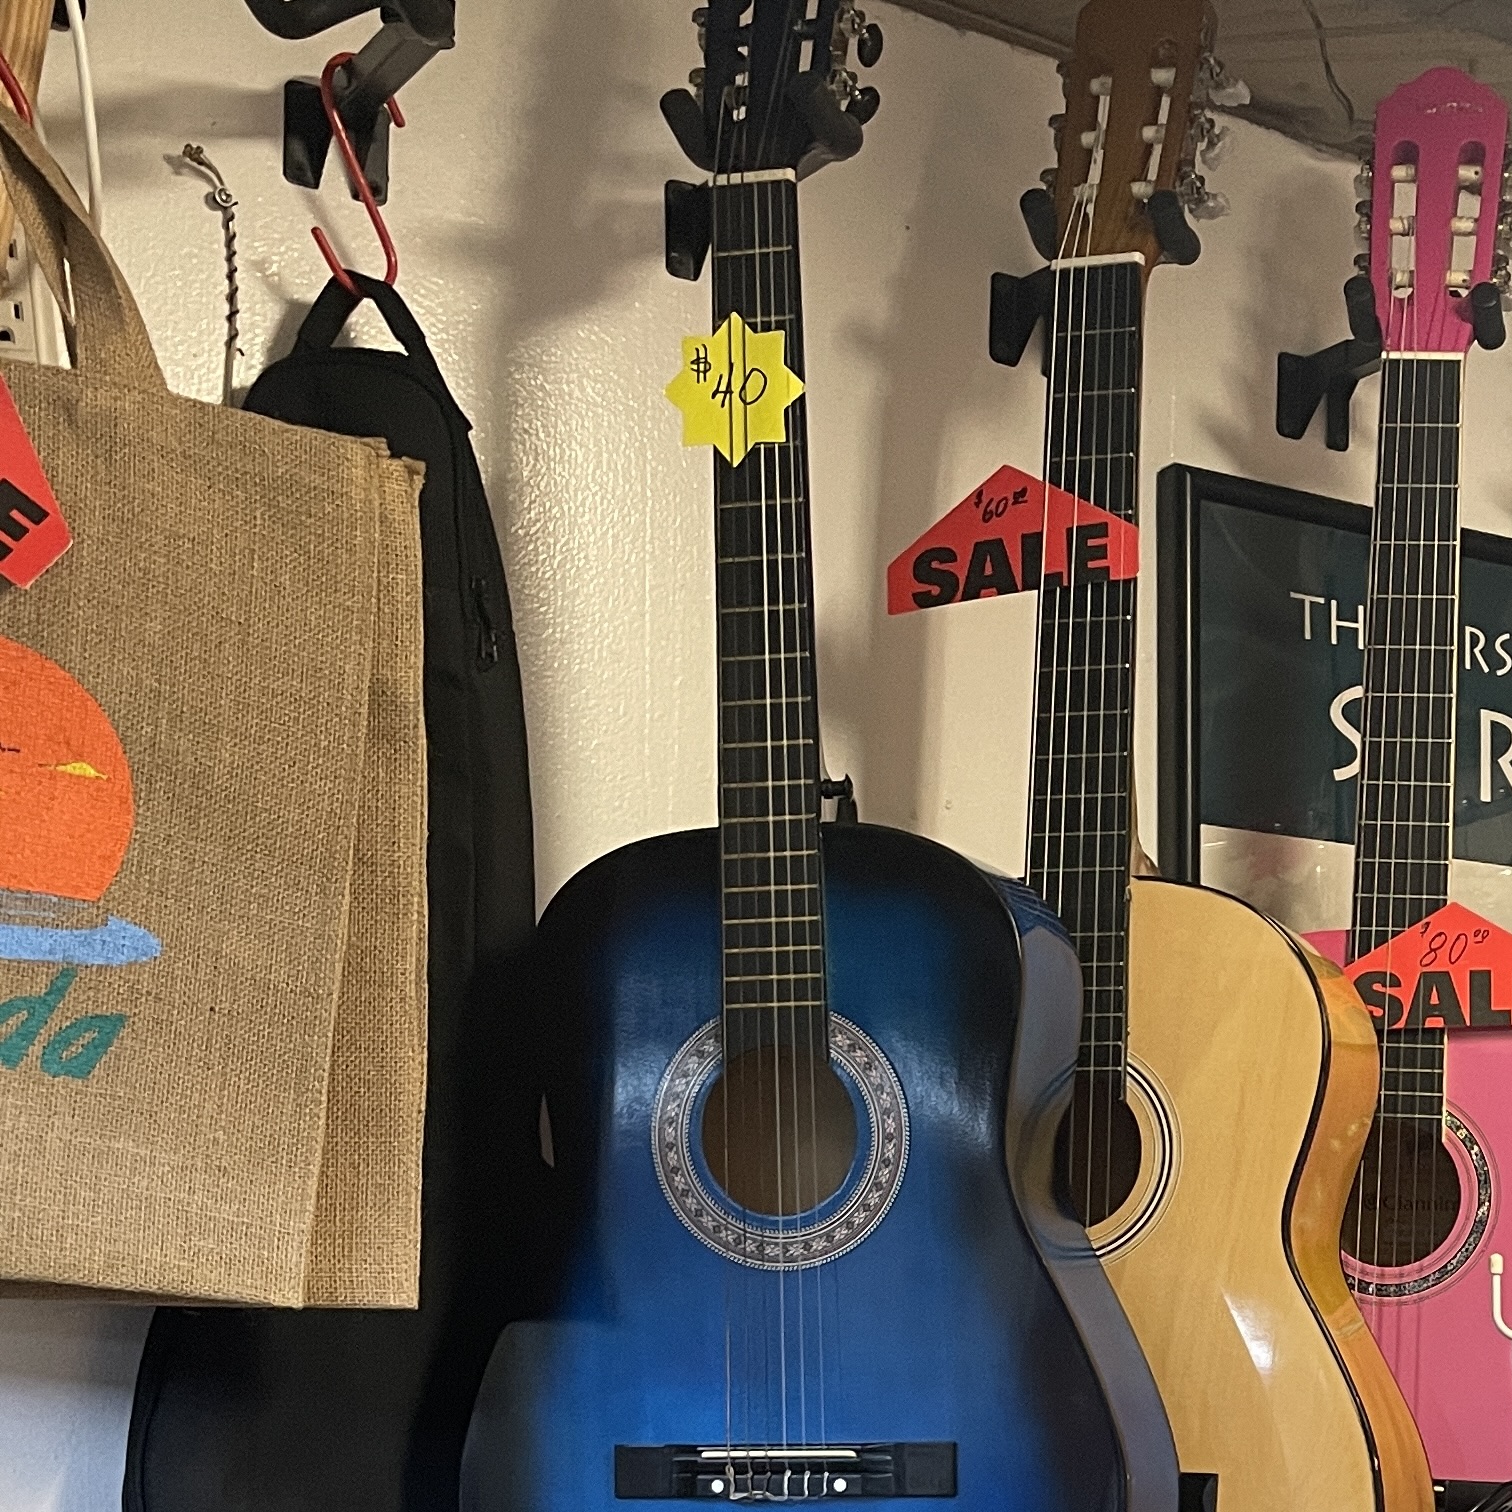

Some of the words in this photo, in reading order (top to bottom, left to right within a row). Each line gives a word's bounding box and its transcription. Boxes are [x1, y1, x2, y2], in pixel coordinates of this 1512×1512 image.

[690, 343, 768, 409] $40
[911, 521, 1112, 609] SALE
[1290, 591, 1364, 650] TH
